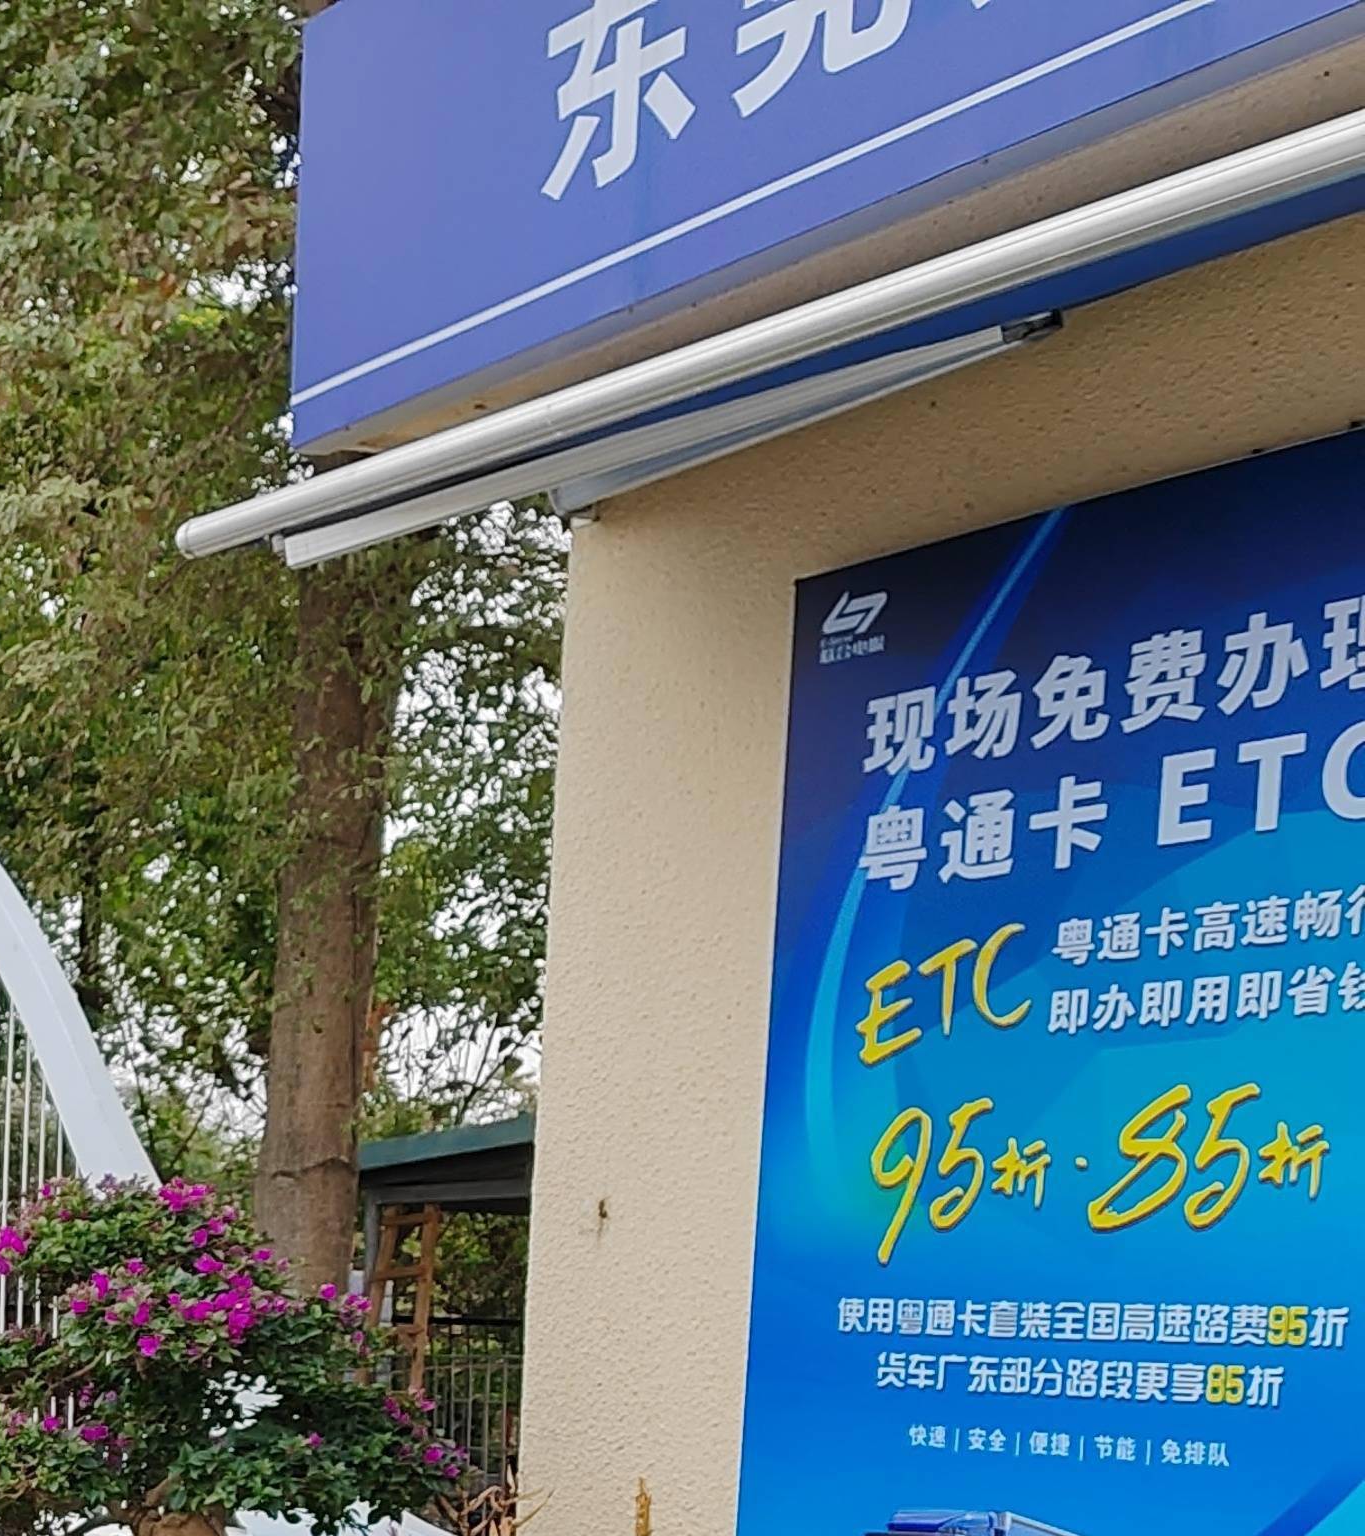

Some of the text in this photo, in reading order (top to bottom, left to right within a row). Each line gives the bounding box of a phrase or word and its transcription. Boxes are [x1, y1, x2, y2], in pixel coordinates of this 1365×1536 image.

[859, 776, 1107, 890] 粤通卡
[855, 922, 1032, 1064] ETC
[876, 1352, 1285, 1407] 货车广东部分路段更享85折
[967, 1427, 1006, 1451] 安全
